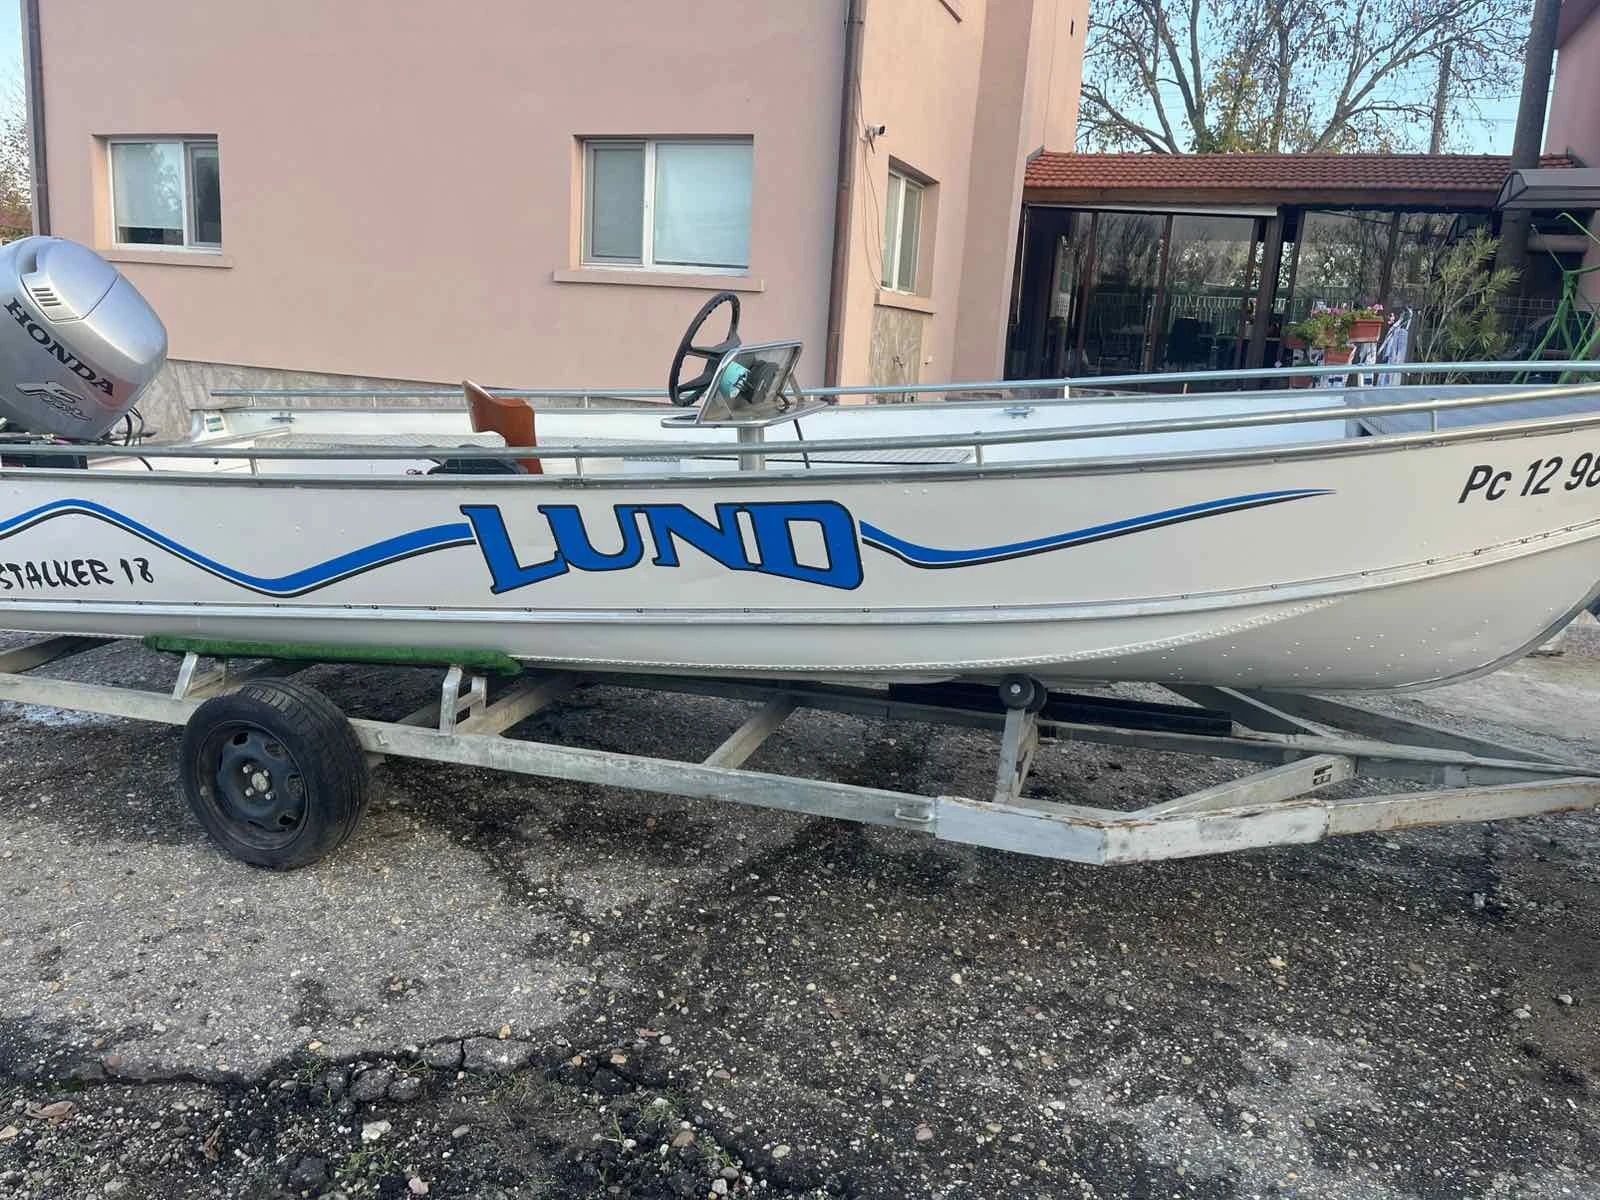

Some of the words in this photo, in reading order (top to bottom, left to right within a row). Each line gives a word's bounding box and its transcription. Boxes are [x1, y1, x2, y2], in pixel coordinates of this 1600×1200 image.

[4, 297, 115, 396] HONDA
[1520, 456, 1563, 497] 12
[0, 559, 114, 590] STALKER
[120, 558, 154, 584] 18
[459, 500, 865, 595] LUND
